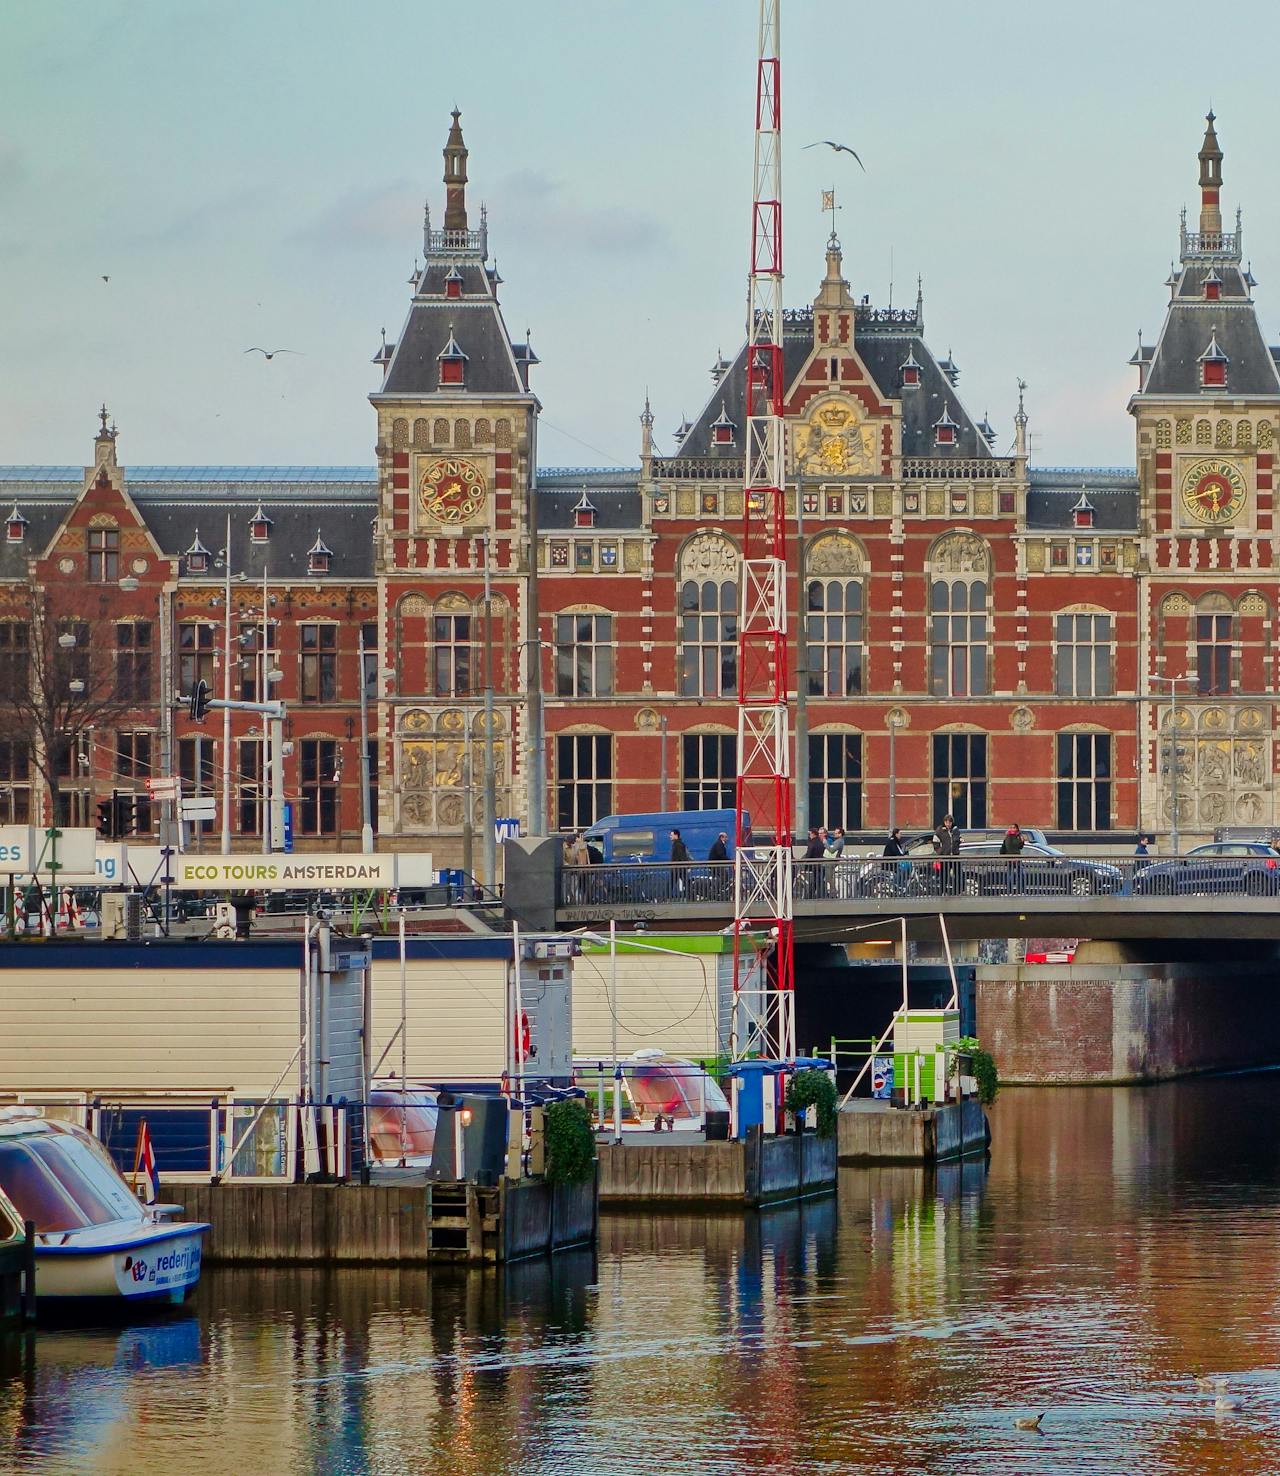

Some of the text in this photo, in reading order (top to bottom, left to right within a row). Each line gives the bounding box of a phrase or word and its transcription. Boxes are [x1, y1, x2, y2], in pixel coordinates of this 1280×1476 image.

[447, 462, 458, 474] N
[470, 485, 481, 497] O
[447, 508, 458, 520] Z
[184, 865, 380, 880] ECO TOURS AMSTERDAM
[157, 1248, 190, 1271] rederij
